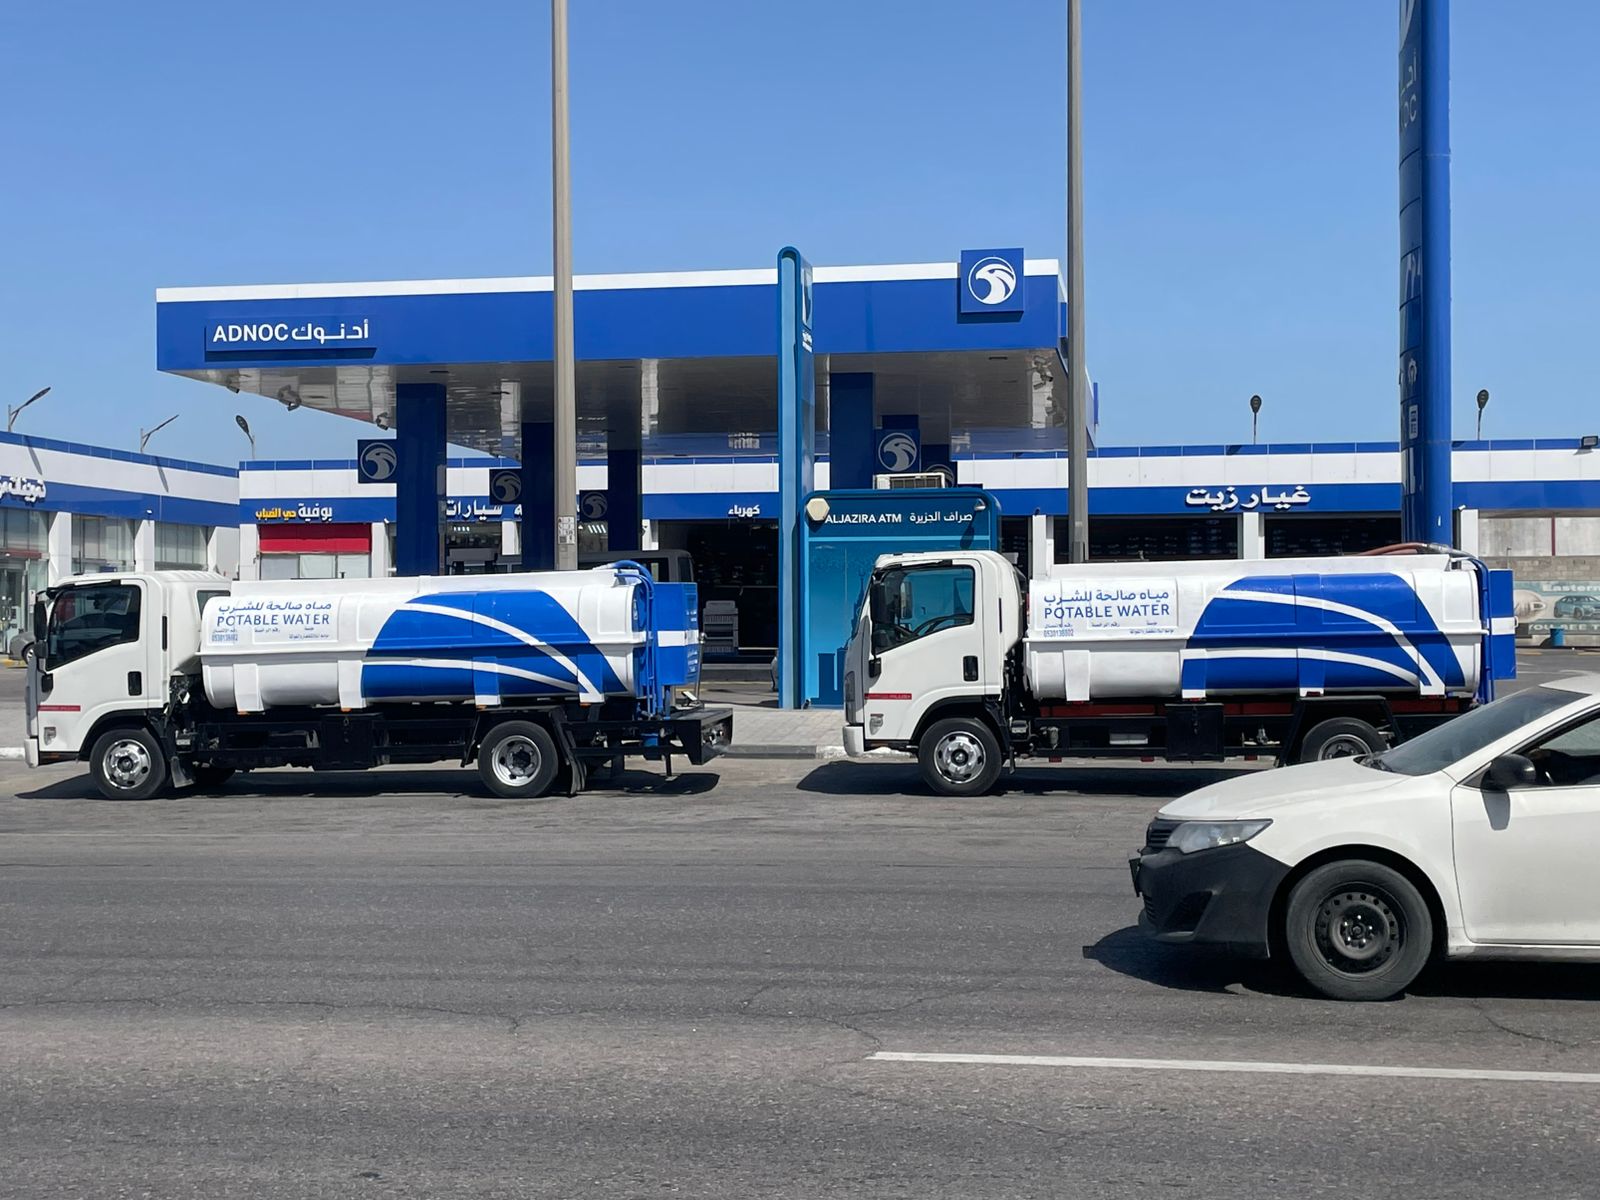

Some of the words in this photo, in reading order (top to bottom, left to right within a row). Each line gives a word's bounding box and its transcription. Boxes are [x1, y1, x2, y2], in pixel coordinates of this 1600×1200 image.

[212, 323, 289, 342] ADNOC
[291, 318, 369, 344] أدنوك
[1186, 486, 1239, 511] زيت
[1240, 485, 1311, 510] غيار
[728, 504, 760, 518] كهرباء
[943, 511, 973, 524] صراف
[824, 513, 877, 524] ALJAZIRA
[878, 513, 902, 523] ATM
[909, 512, 941, 525] الجزيرة
[1044, 589, 1092, 606] للشرب
[1096, 589, 1137, 601] صالحة
[1139, 588, 1169, 603] مياه
[218, 601, 265, 615] للشرب
[266, 600, 303, 611] صالحة
[1044, 605, 1113, 619] POTABLE
[1117, 603, 1170, 617] WATER
[216, 614, 279, 627] POTABLE
[283, 613, 330, 626] WATER
